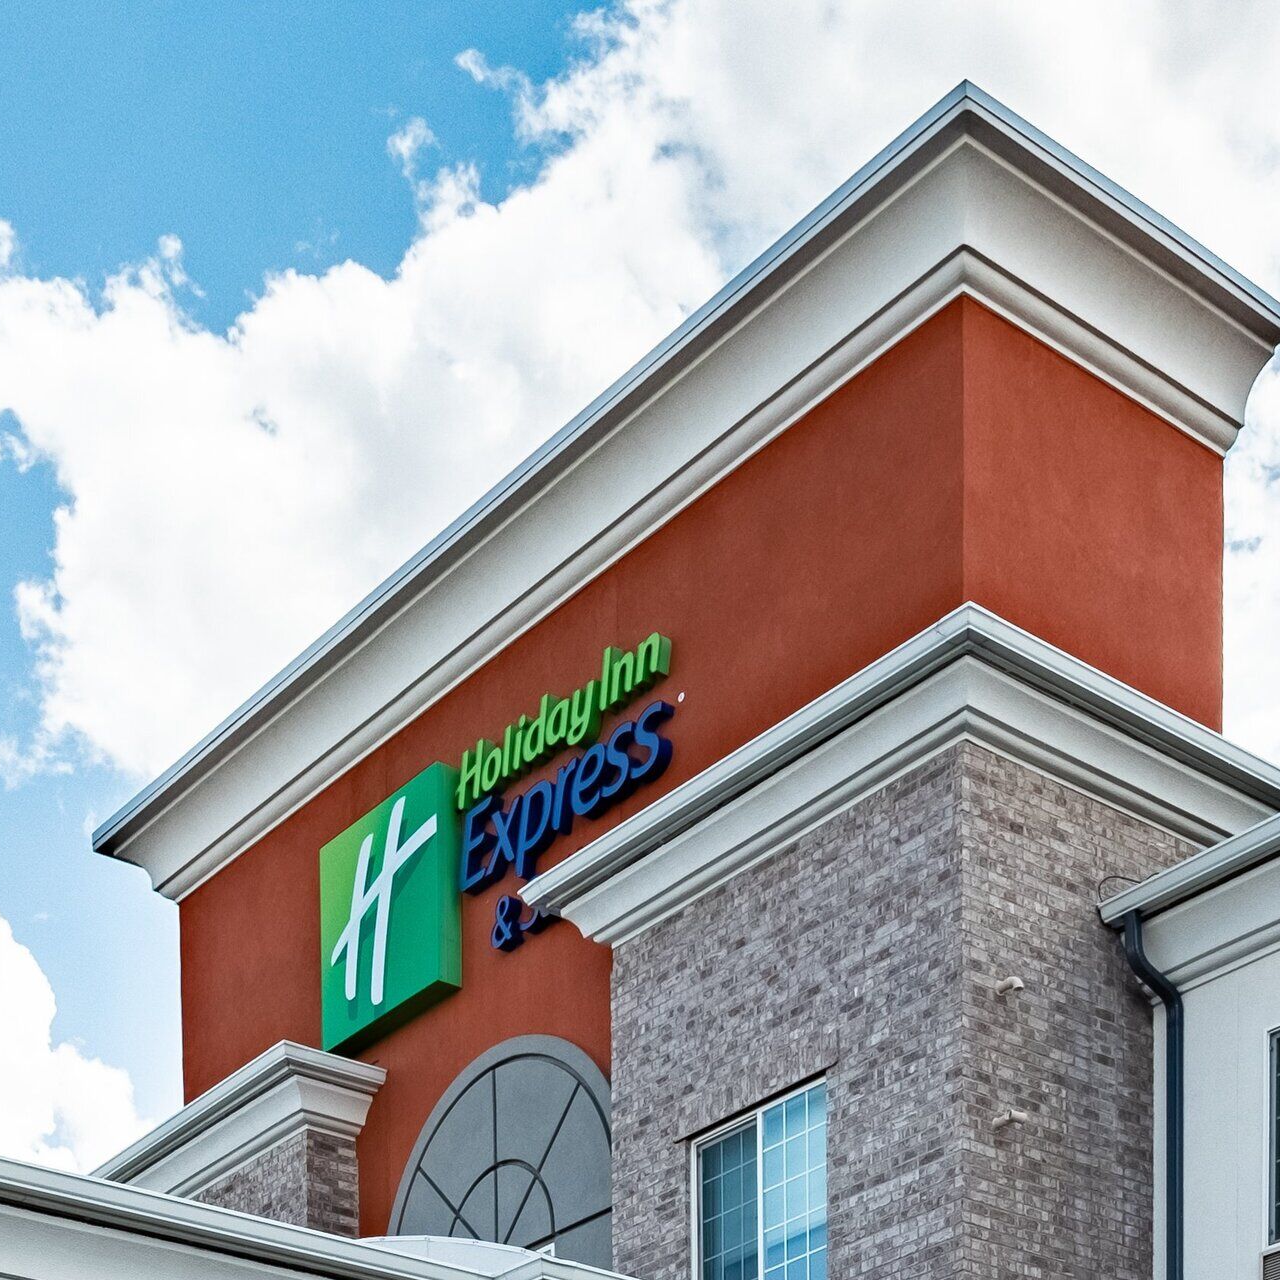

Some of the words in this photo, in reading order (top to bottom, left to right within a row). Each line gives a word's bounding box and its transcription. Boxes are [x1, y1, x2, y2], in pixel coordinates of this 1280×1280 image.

[455, 679, 600, 810] Holiday
[599, 631, 671, 711] Inn
[460, 700, 674, 893] Express
[491, 894, 523, 950] &
